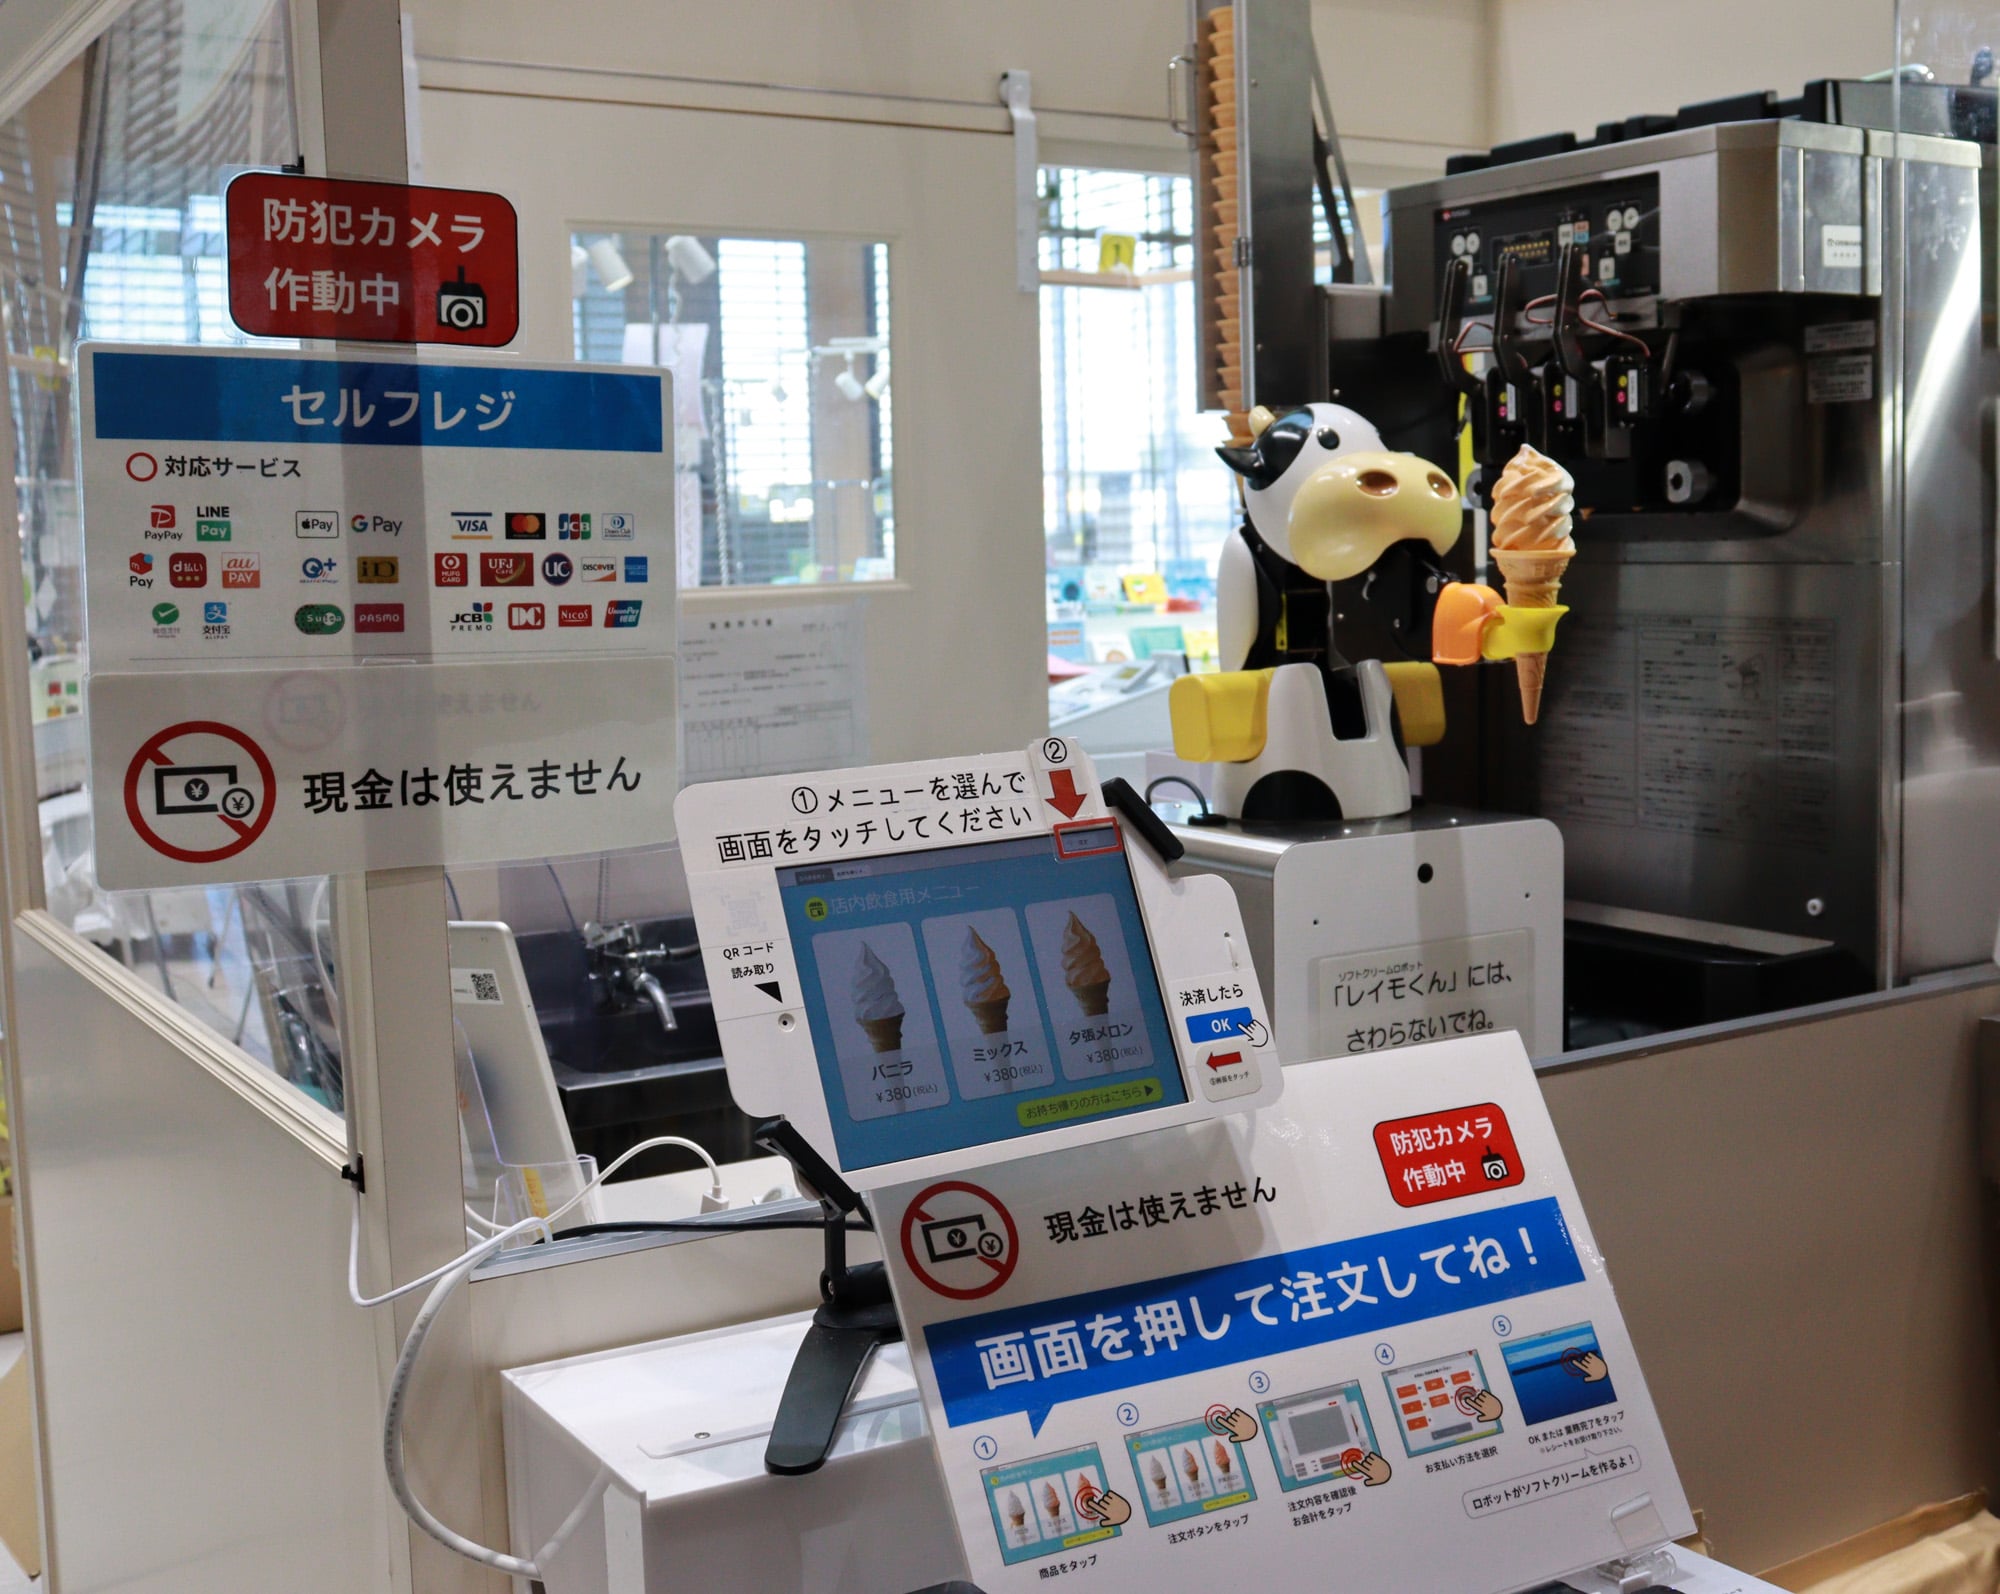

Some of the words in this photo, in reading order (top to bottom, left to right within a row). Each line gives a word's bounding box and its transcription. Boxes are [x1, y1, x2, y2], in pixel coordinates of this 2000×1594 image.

[262, 198, 486, 254] 防犯カメラ
[263, 266, 400, 317] 作動中
[281, 385, 516, 431] セルフレジ
[165, 456, 301, 478] 対応サービス
[197, 506, 229, 517] LINE
[144, 531, 183, 541] PayPay
[201, 525, 227, 538] Pay
[373, 516, 402, 536] Pay
[456, 520, 488, 531] VISA
[227, 558, 254, 569] au
[488, 559, 513, 569] UFJ
[545, 561, 570, 577] UC
[130, 576, 153, 588] Pay
[229, 573, 253, 583] PAY
[450, 613, 482, 623] JCB
[303, 756, 641, 814] 現金は使えません
[827, 771, 1025, 812] メニューを選んで
[715, 804, 1033, 863] 画面をタッチしてください
[831, 886, 980, 914] 店内飲食用メニュー
[731, 962, 775, 979] 読み取り
[1338, 961, 1424, 982] ソフトクリームロボット
[1179, 984, 1244, 1007] 決済したら
[1334, 961, 1512, 1008] 「レイモくん」には、
[1068, 1023, 1134, 1046] 夕張メロン
[1211, 1019, 1232, 1033] OK
[1347, 1009, 1494, 1052] さわらないでね。
[973, 1041, 1029, 1063] ミックス
[872, 1060, 913, 1081] バニラ
[1025, 1087, 1143, 1119] お持ち帰りの方はこちら
[1390, 1117, 1493, 1157] 防犯カメラ
[1403, 1159, 1466, 1192] 作動中
[1043, 1175, 1278, 1245] 現金は使えません
[975, 1227, 1539, 1391] 画面を押して注文してね！
[1425, 1446, 1498, 1474] お支払い方法を選択
[1472, 1454, 1635, 1510] ロボットがソフトクリームを作るよ！
[1288, 1486, 1357, 1512] 注文内容を確認後
[1292, 1502, 1352, 1527] お会計をタップ
[1168, 1514, 1249, 1545] 注文ボタンをタップ
[1039, 1554, 1098, 1580] 商品をタップ
